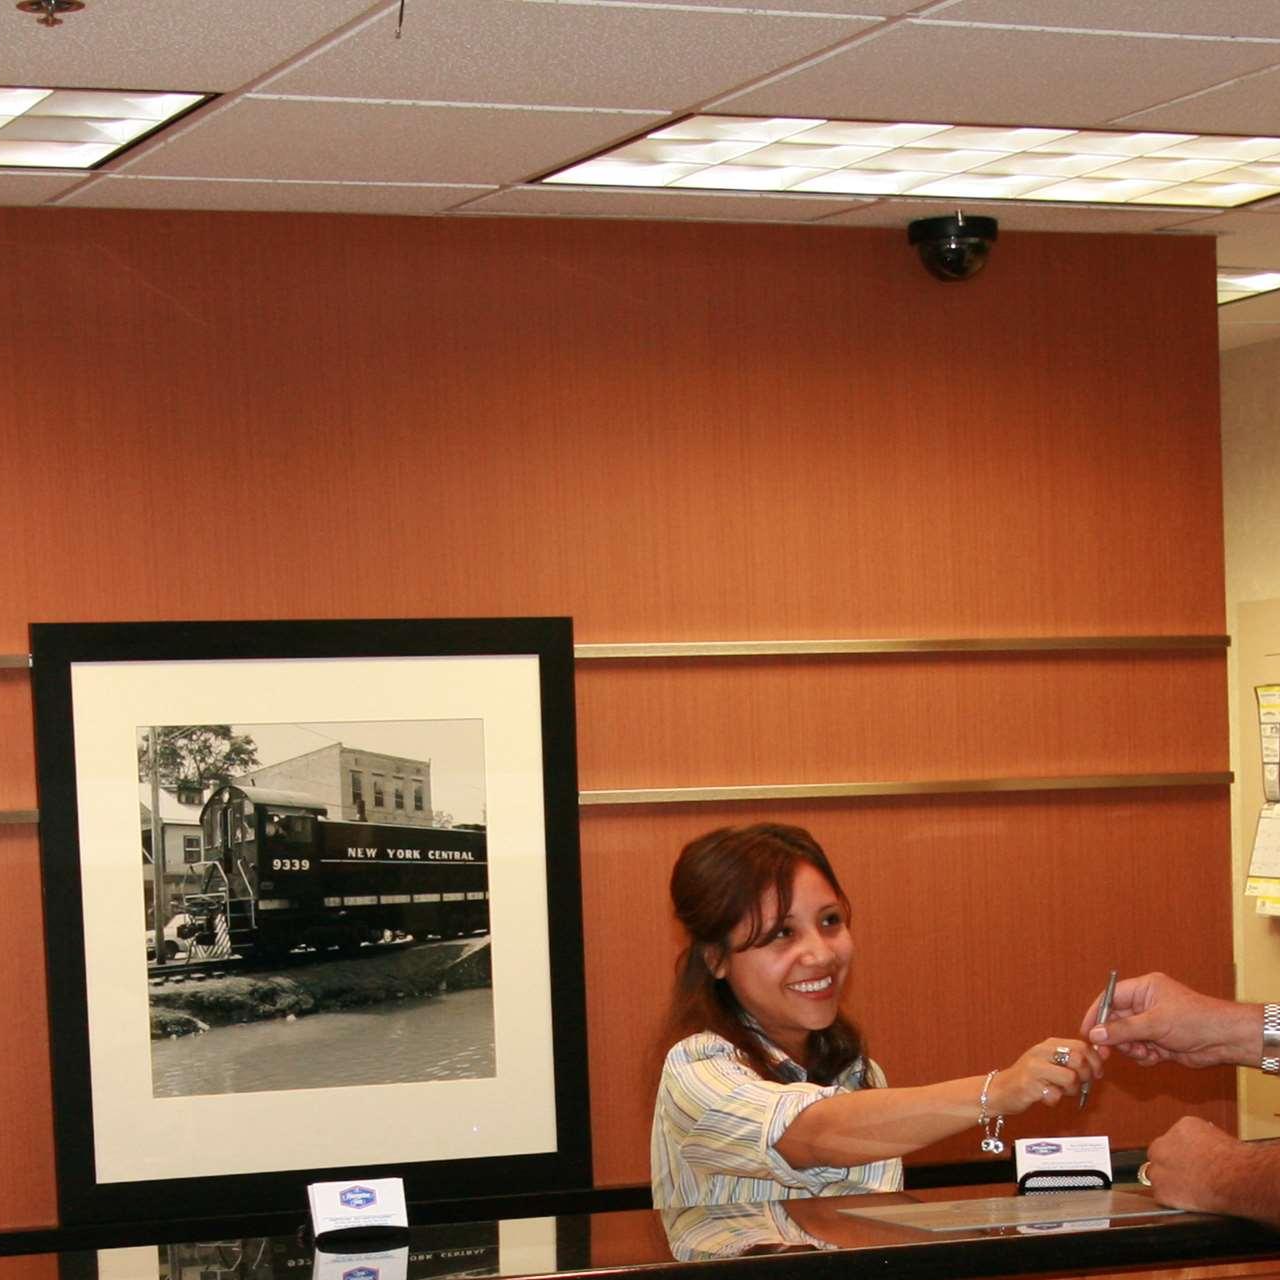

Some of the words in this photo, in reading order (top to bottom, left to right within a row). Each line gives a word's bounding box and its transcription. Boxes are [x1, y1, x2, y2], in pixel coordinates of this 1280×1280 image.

[347, 847, 378, 859] NEW
[387, 848, 421, 859] YORK
[427, 850, 475, 861] CENTRAL
[272, 859, 310, 871] 9339
